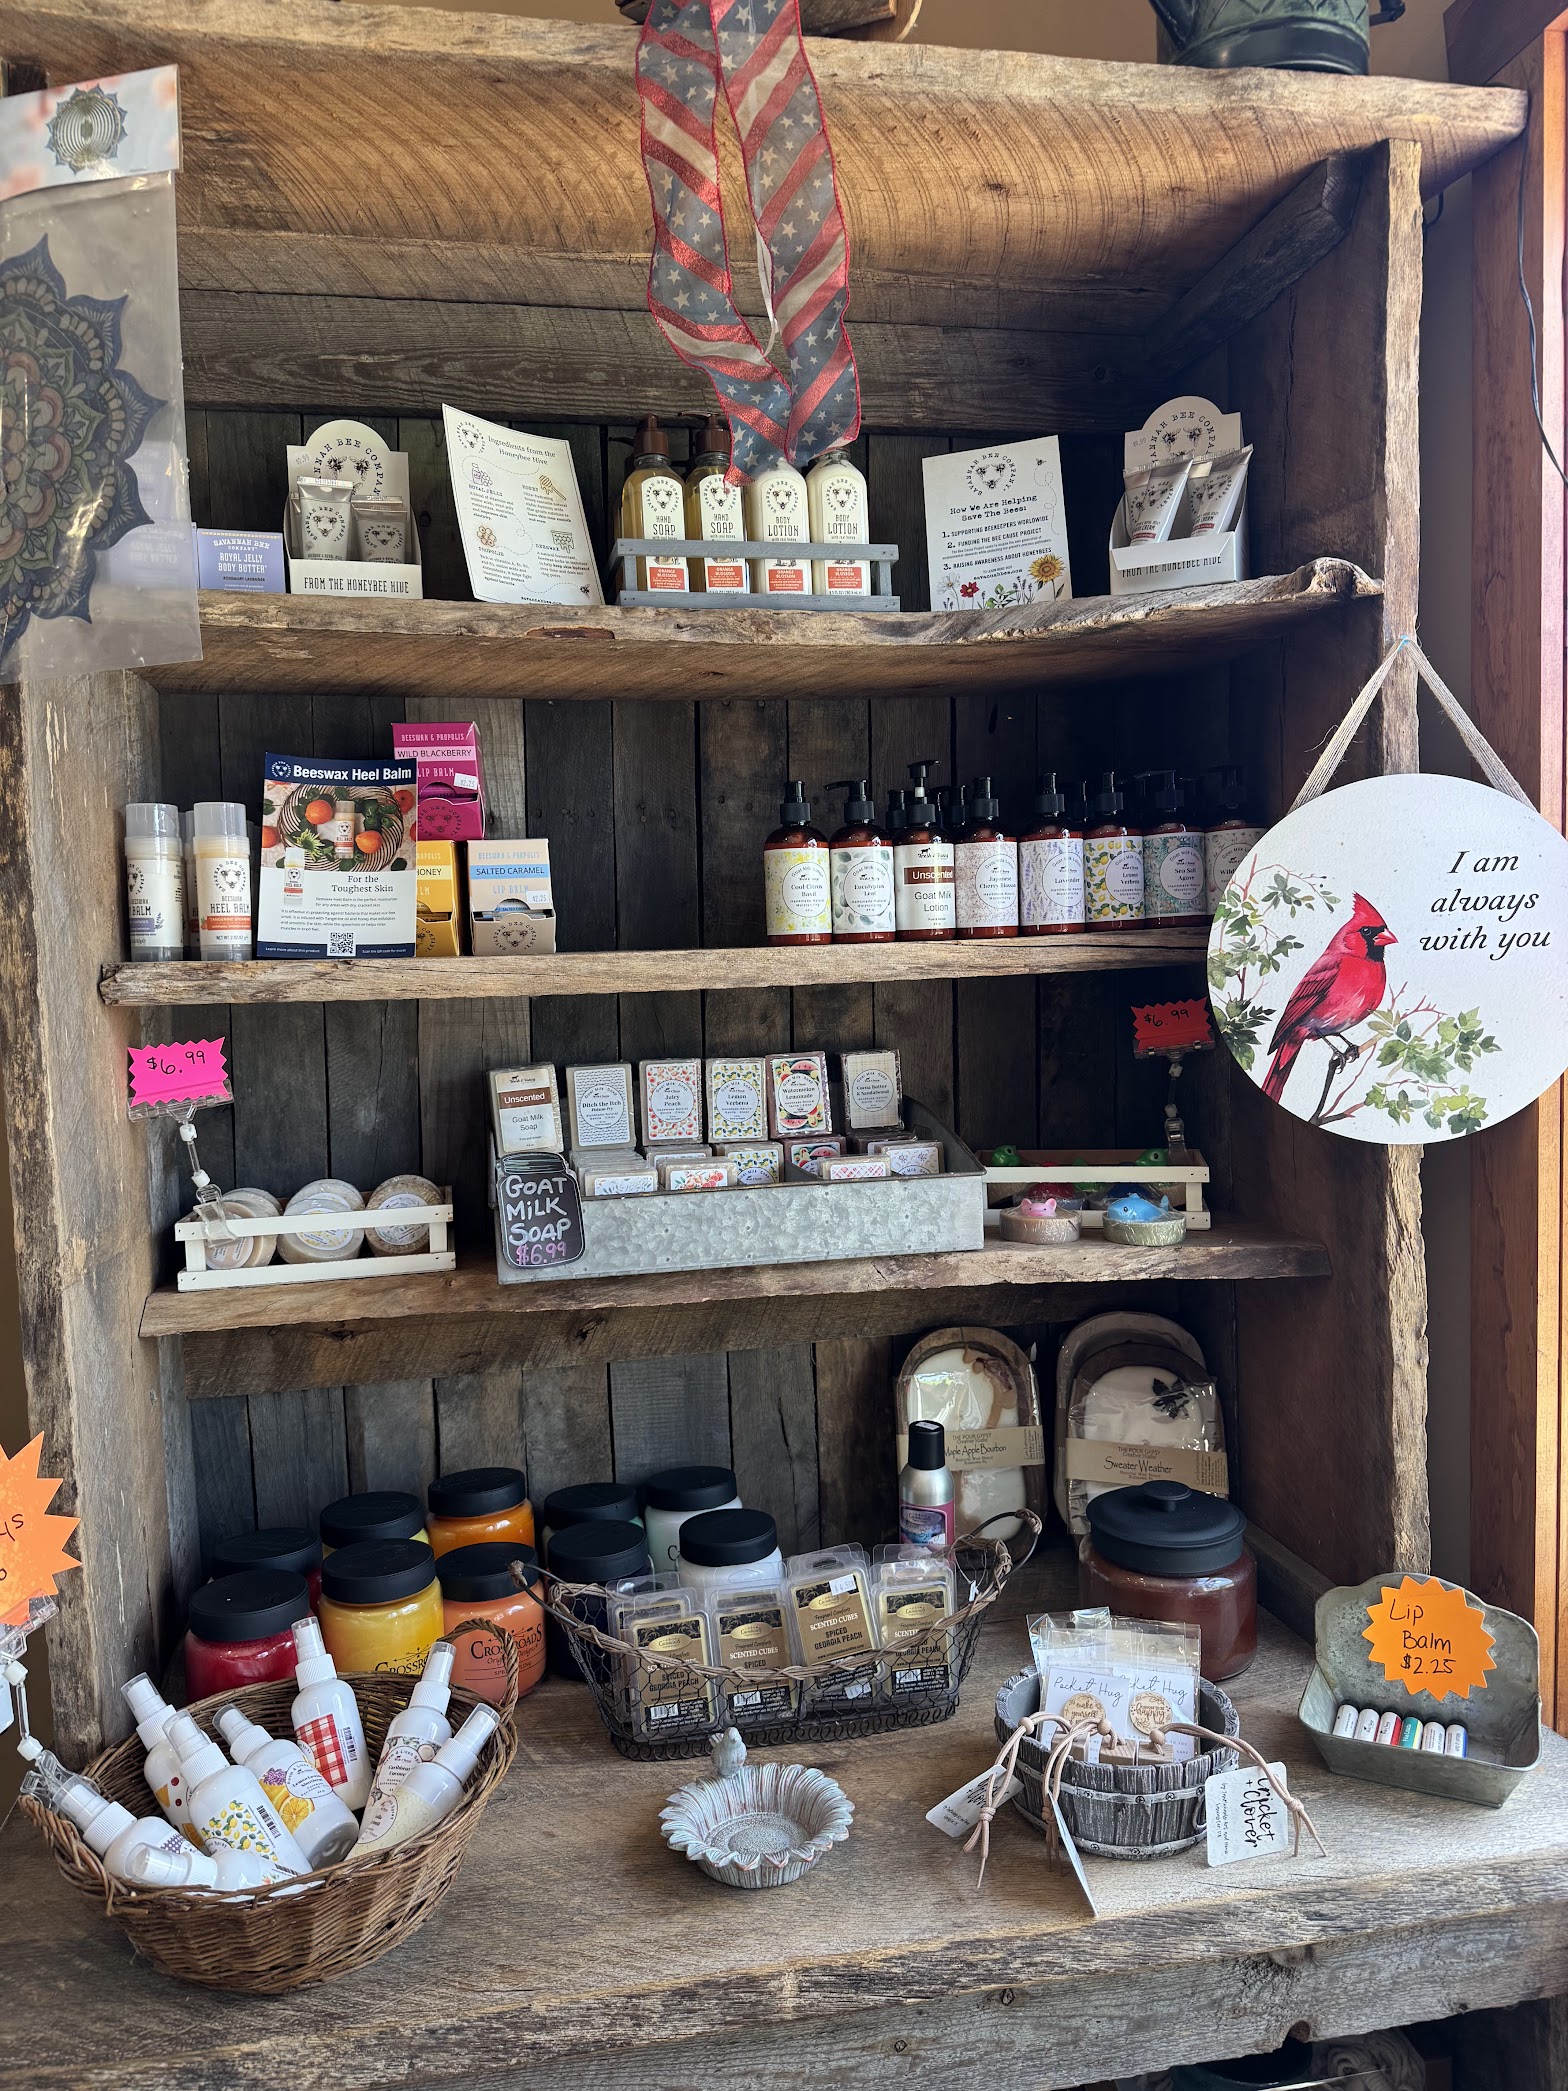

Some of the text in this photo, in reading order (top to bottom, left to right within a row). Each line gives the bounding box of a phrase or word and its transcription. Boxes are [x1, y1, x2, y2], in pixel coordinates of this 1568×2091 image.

[488, 435, 556, 458] Ingredients from the
[499, 448, 548, 466] Honeybee Hive
[950, 507, 967, 515] How
[983, 501, 999, 510] Are
[1001, 495, 1038, 506] Helping
[655, 515, 671, 524] HAND
[713, 513, 729, 521] HAND
[775, 516, 791, 524] BODY
[835, 514, 850, 522] BODY
[961, 514, 982, 522] Save
[984, 510, 1001, 518] The
[653, 523, 676, 536] SOAP
[710, 522, 734, 534] SOAP
[768, 524, 799, 537] LOTION
[827, 522, 858, 535] LOTION
[942, 515, 1049, 539] 1. SUPPORTING BEEKEEPERS WORLDWIDE
[213, 538, 271, 550] SAVANNAH BEE
[947, 541, 956, 549] 2.
[958, 539, 980, 547] FUNDING
[1002, 532, 1019, 540] CAUSE
[1019, 527, 1042, 537] PROJECT
[219, 552, 263, 564] ROYAL JELLY
[943, 563, 951, 571] 3.
[953, 560, 973, 569] RAISING
[974, 556, 1004, 566] AWARENESS
[1004, 552, 1021, 561] ABOUT
[1022, 547, 1052, 557] HONEYBEES
[218, 562, 265, 574] BODY BUTTER
[304, 577, 410, 594] FROM THE HONEYBEE HIVE
[401, 734, 429, 742] BEESWAX
[436, 733, 465, 741] PROPOLIS
[397, 749, 472, 758] WILD BLACKBERRY
[293, 764, 412, 781] Beeswax Heel Balm
[417, 767, 455, 778] LIP BALM
[460, 779, 475, 788] $2.25
[478, 852, 505, 860] BEESWAX
[512, 851, 540, 859] PROPOLIS
[1448, 850, 1519, 874] I am
[476, 867, 545, 876] SALTED CARAMEL
[912, 870, 953, 880] Unscented
[347, 875, 379, 883] For the
[331, 884, 394, 894] Toughest Skin
[492, 884, 529, 894] LIP BALM
[532, 895, 547, 903] $2.25
[914, 891, 952, 901] Goat Milk
[210, 902, 231, 914] HEEL
[923, 903, 949, 912] Lotion
[1430, 888, 1540, 923] always
[1419, 925, 1551, 962] with you
[1143, 1008, 1189, 1027] $6.99
[146, 1050, 206, 1075] $6.99
[504, 1092, 545, 1104] Unscented
[512, 1113, 544, 1123] Goat Milk
[520, 1123, 538, 1131] Soap
[505, 1175, 567, 1198] GOAT
[508, 1217, 572, 1246] SOAP
[516, 1241, 567, 1266] $6.99
[961, 1444, 980, 1459] Apple
[980, 1442, 1007, 1455] Bourbon
[1103, 1456, 1173, 1474] Sweater Weather
[1388, 1598, 1424, 1626] Lip
[810, 1613, 859, 1631] SCENTED CUBES
[825, 1626, 848, 1639] SPICED
[814, 1631, 863, 1650] GEORGIA PEACH
[1402, 1630, 1452, 1655] Balm
[729, 1650, 758, 1660] SCENTED
[743, 1660, 767, 1669] SPICED
[1400, 1653, 1458, 1675] $2.25
[661, 1672, 685, 1681] SPICED
[649, 1678, 699, 1692] GEORGIA PEACH
[1053, 1676, 1124, 1708] Pocket Hug
[1075, 1700, 1094, 1710] make
[1071, 1710, 1099, 1719] yourself
[1256, 1777, 1278, 1841] Cricket
[1240, 1790, 1261, 1848] Clover
